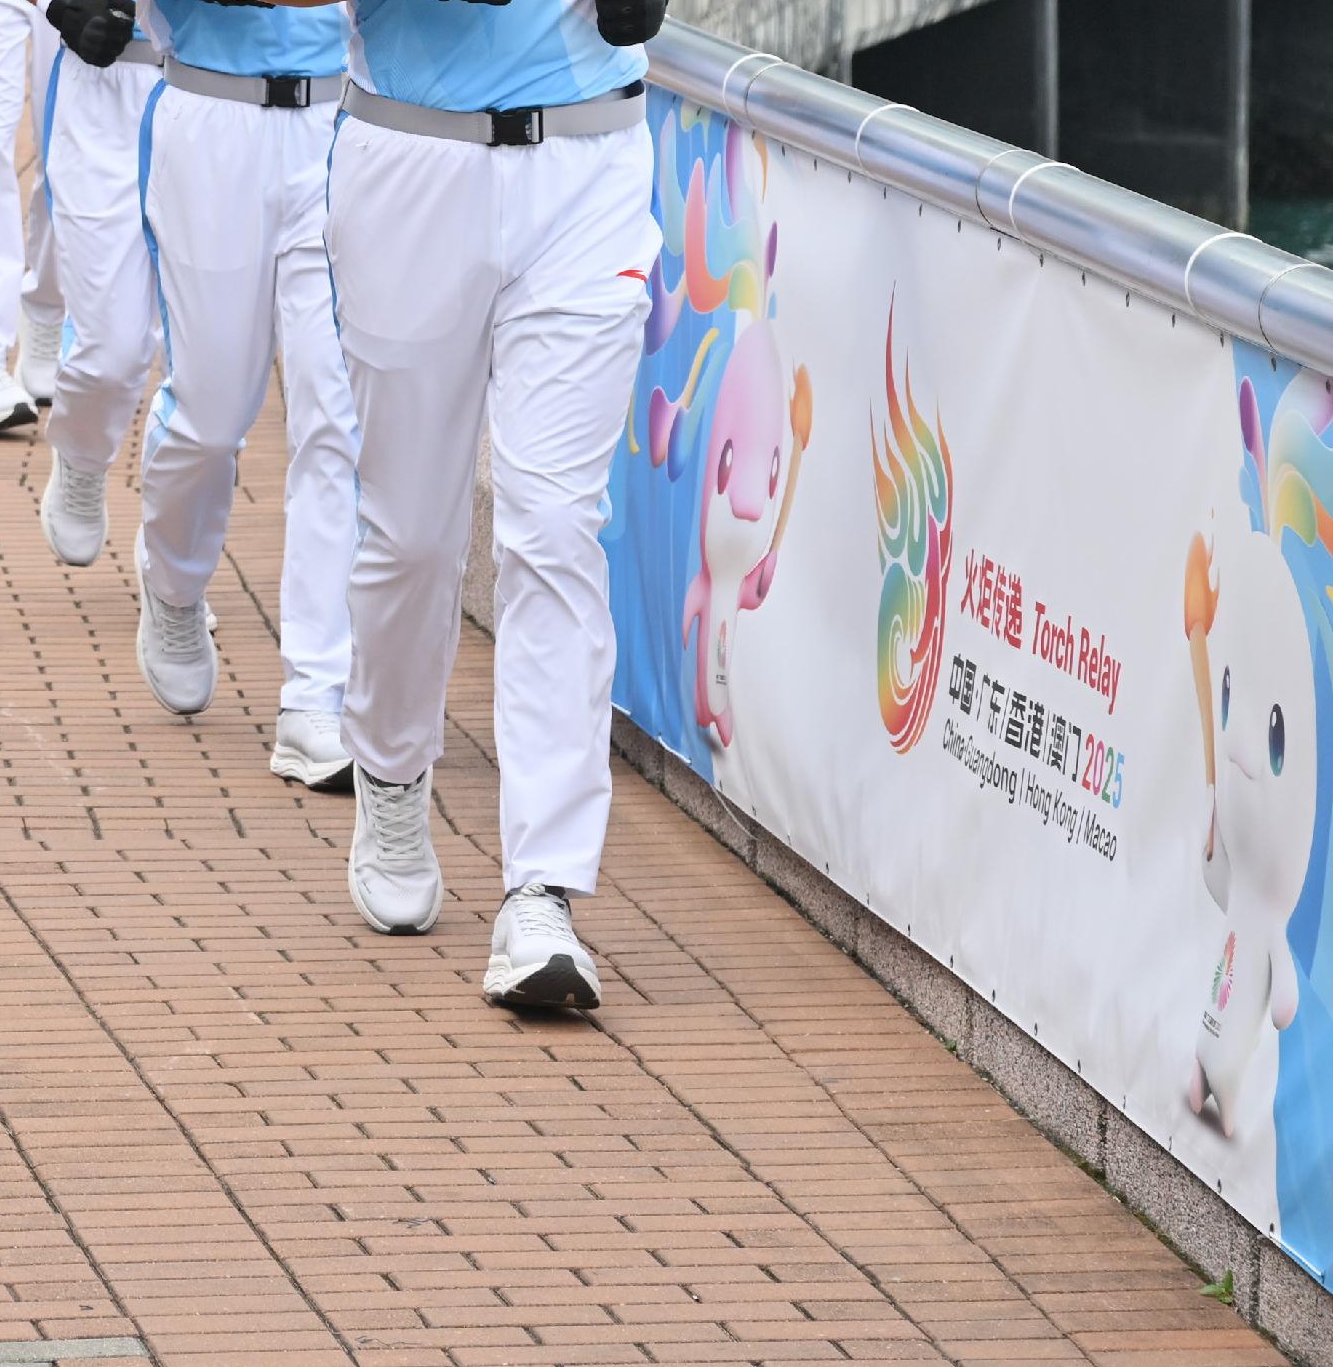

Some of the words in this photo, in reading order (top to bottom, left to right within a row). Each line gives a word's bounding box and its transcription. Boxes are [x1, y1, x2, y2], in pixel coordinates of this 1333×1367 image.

[960, 548, 1023, 650] 火炬传递
[1032, 600, 1075, 676] Torch
[1078, 626, 1122, 716] Relay
[1024, 770, 1051, 826] Hong
[1051, 790, 1079, 844] Kong
[1082, 808, 1118, 862] Macao
[1081, 733, 1126, 809] 2025
